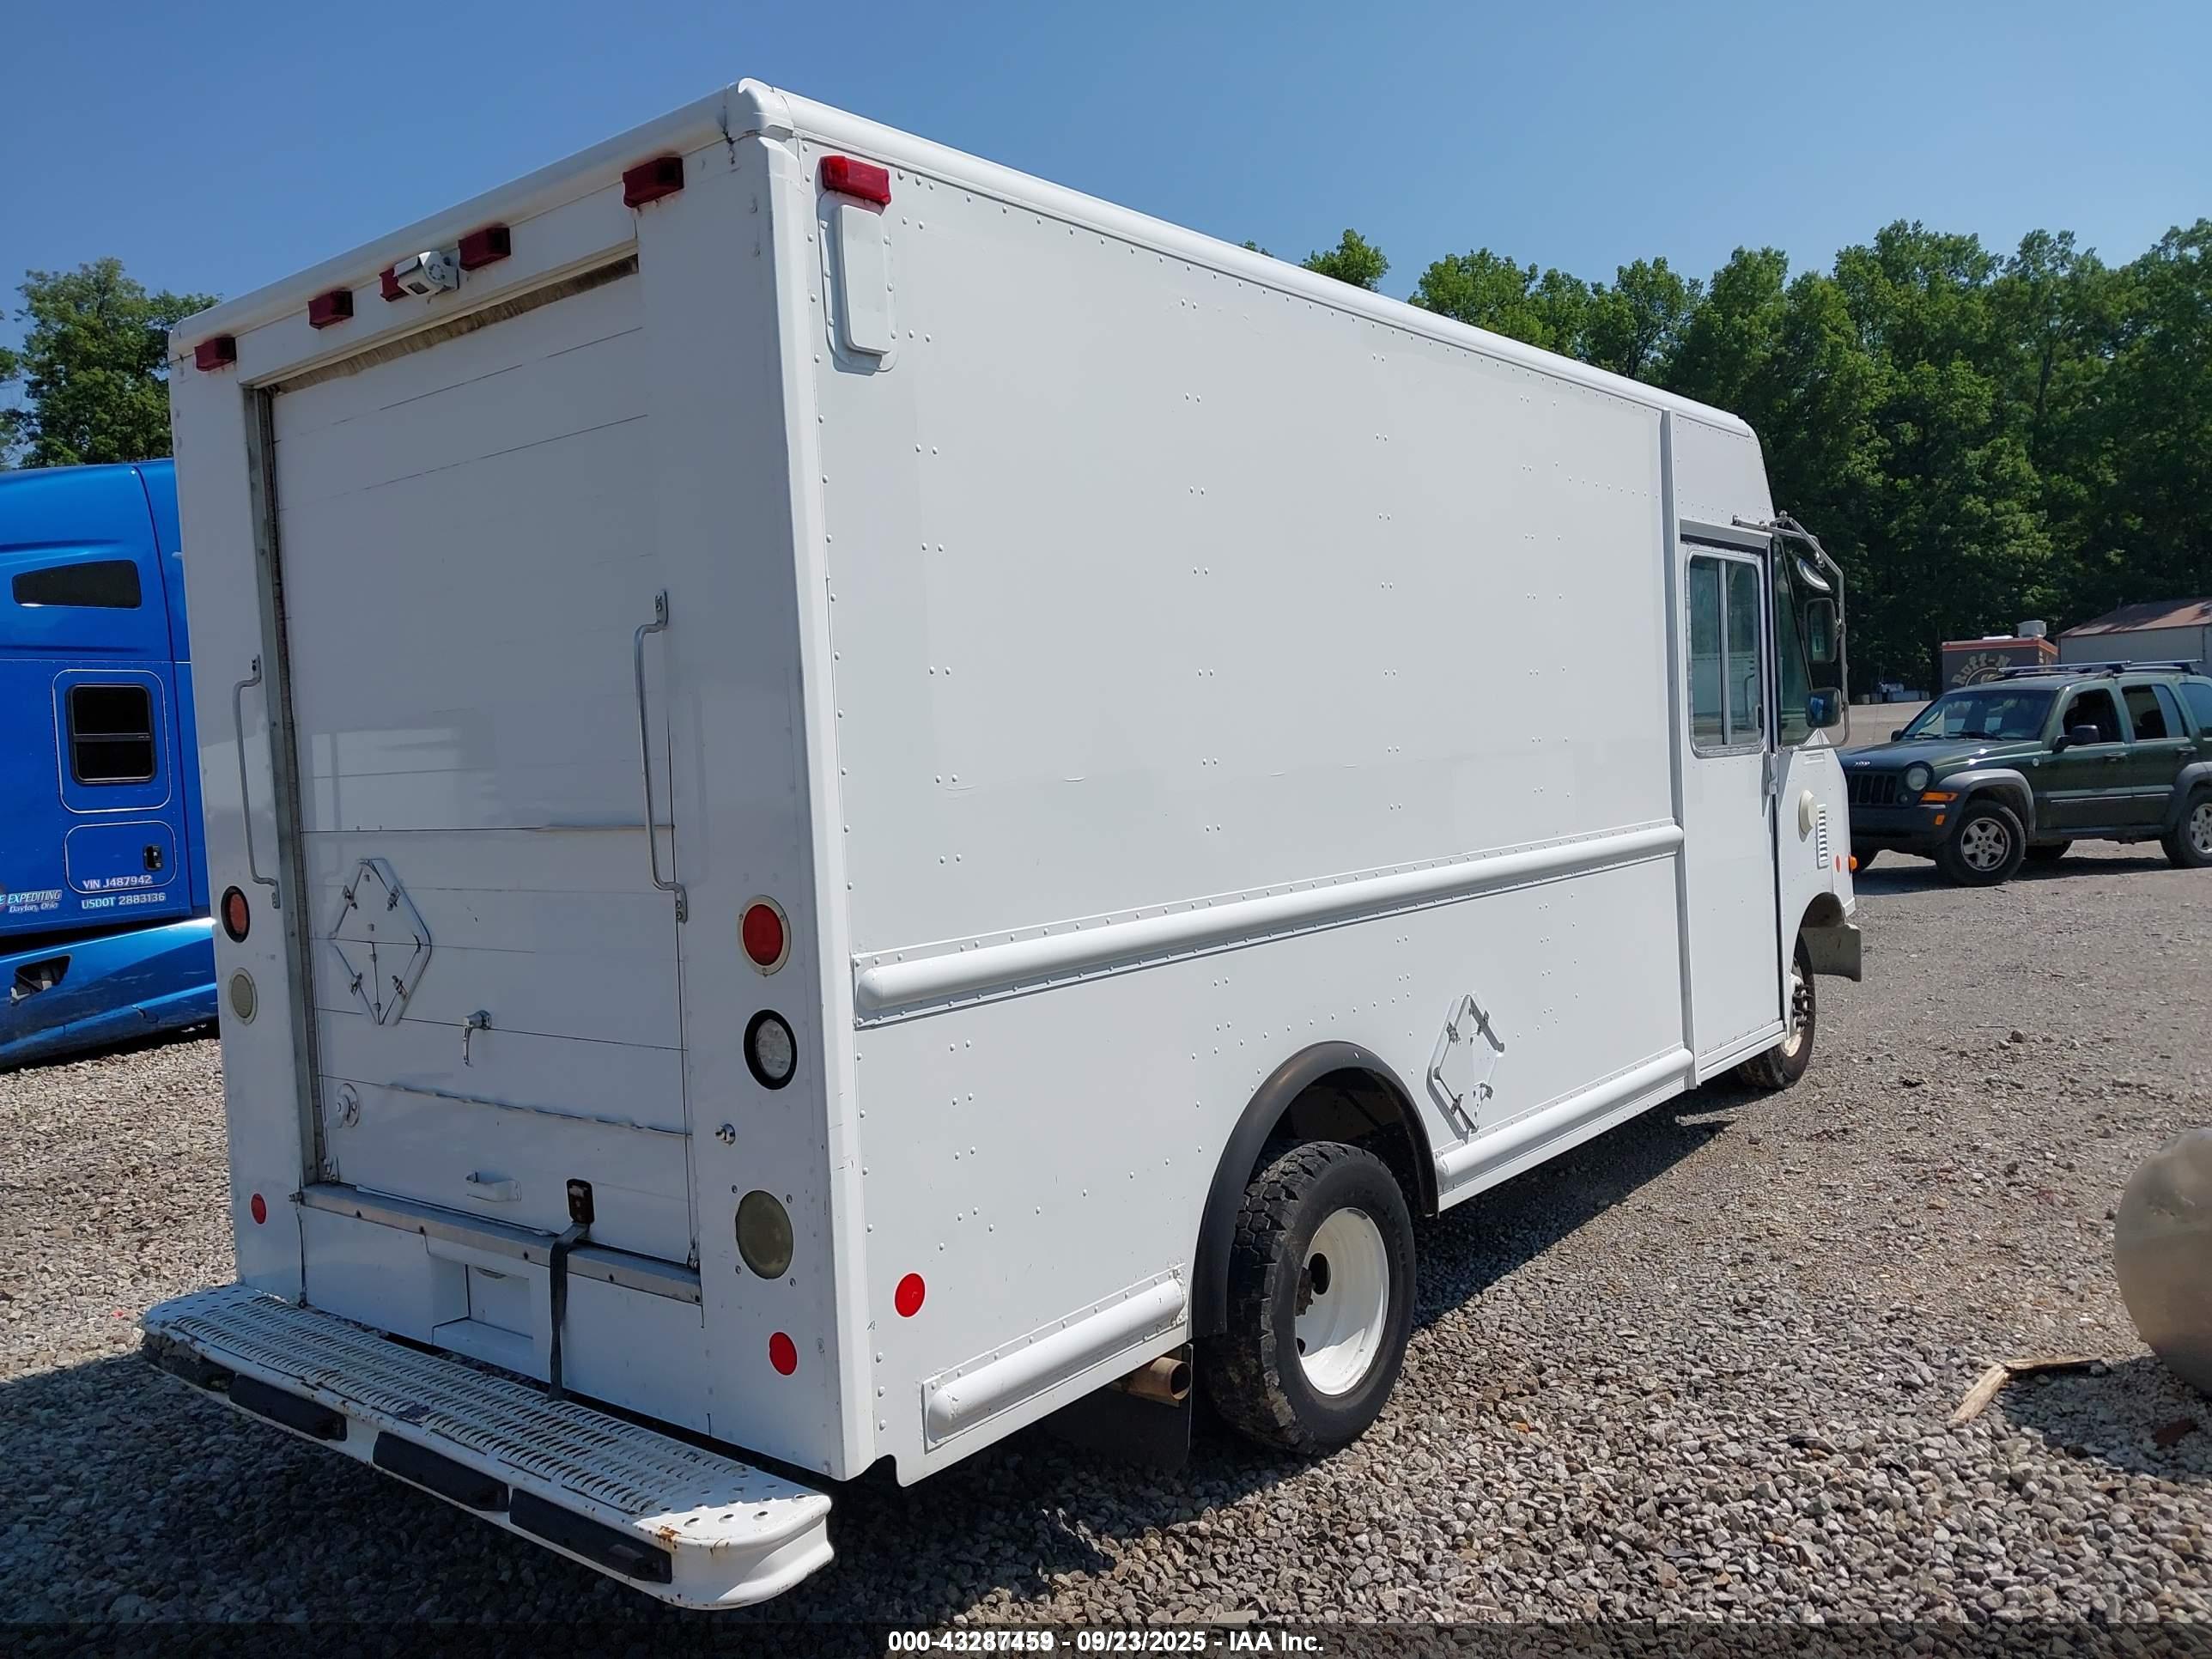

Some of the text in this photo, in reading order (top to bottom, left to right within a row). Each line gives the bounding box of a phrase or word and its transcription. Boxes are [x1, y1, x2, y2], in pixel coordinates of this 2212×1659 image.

[82, 874, 153, 890] VIN J487942
[8, 890, 63, 904] EXPEDITING
[81, 896, 116, 909] USDOT
[40, 902, 59, 911] Ohio
